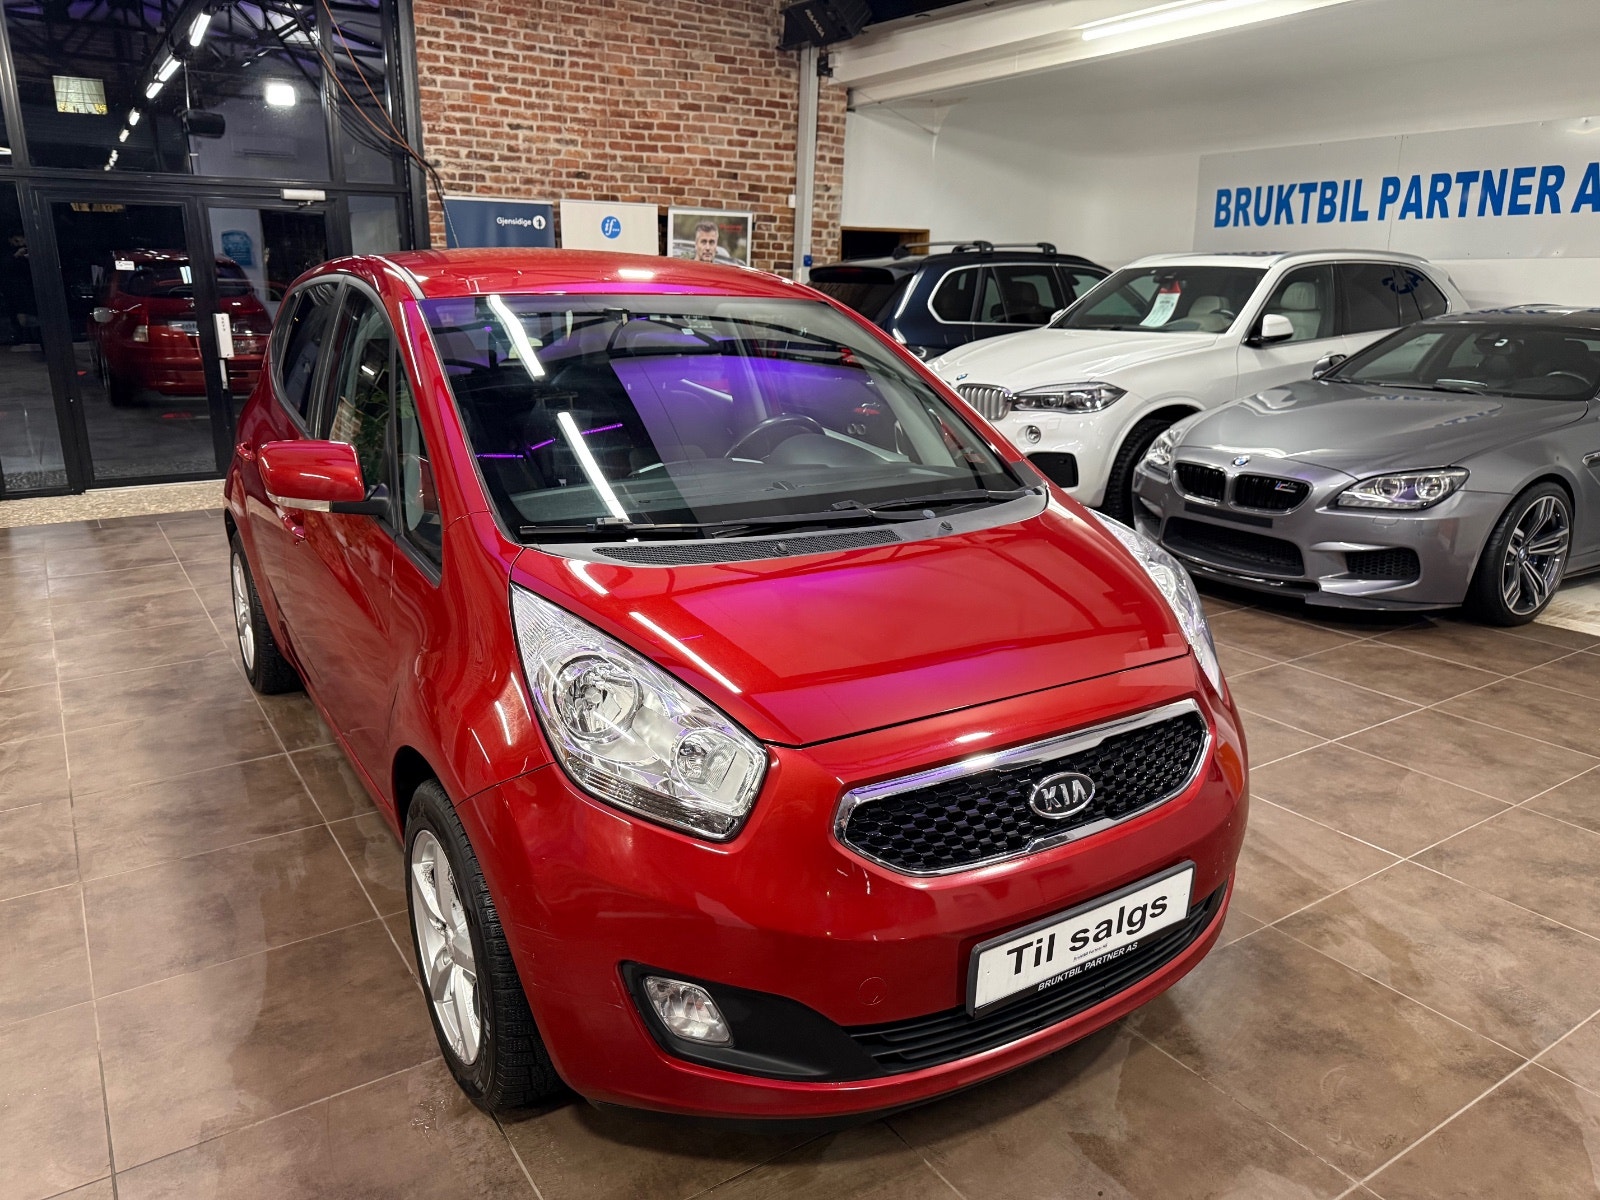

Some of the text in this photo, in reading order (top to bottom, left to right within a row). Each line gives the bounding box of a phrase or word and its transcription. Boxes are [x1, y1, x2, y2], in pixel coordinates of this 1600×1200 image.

[496, 216, 532, 227] Gjensidige
[1213, 178, 1369, 228] BRUKTBIL
[1377, 165, 1566, 221] PARTNER
[1041, 779, 1088, 811] KIA
[1006, 895, 1168, 975] Til salgs
[1037, 965, 1083, 992] BRUKTBIL
[1084, 948, 1125, 971] PARTNER
[1125, 941, 1139, 954] AS
